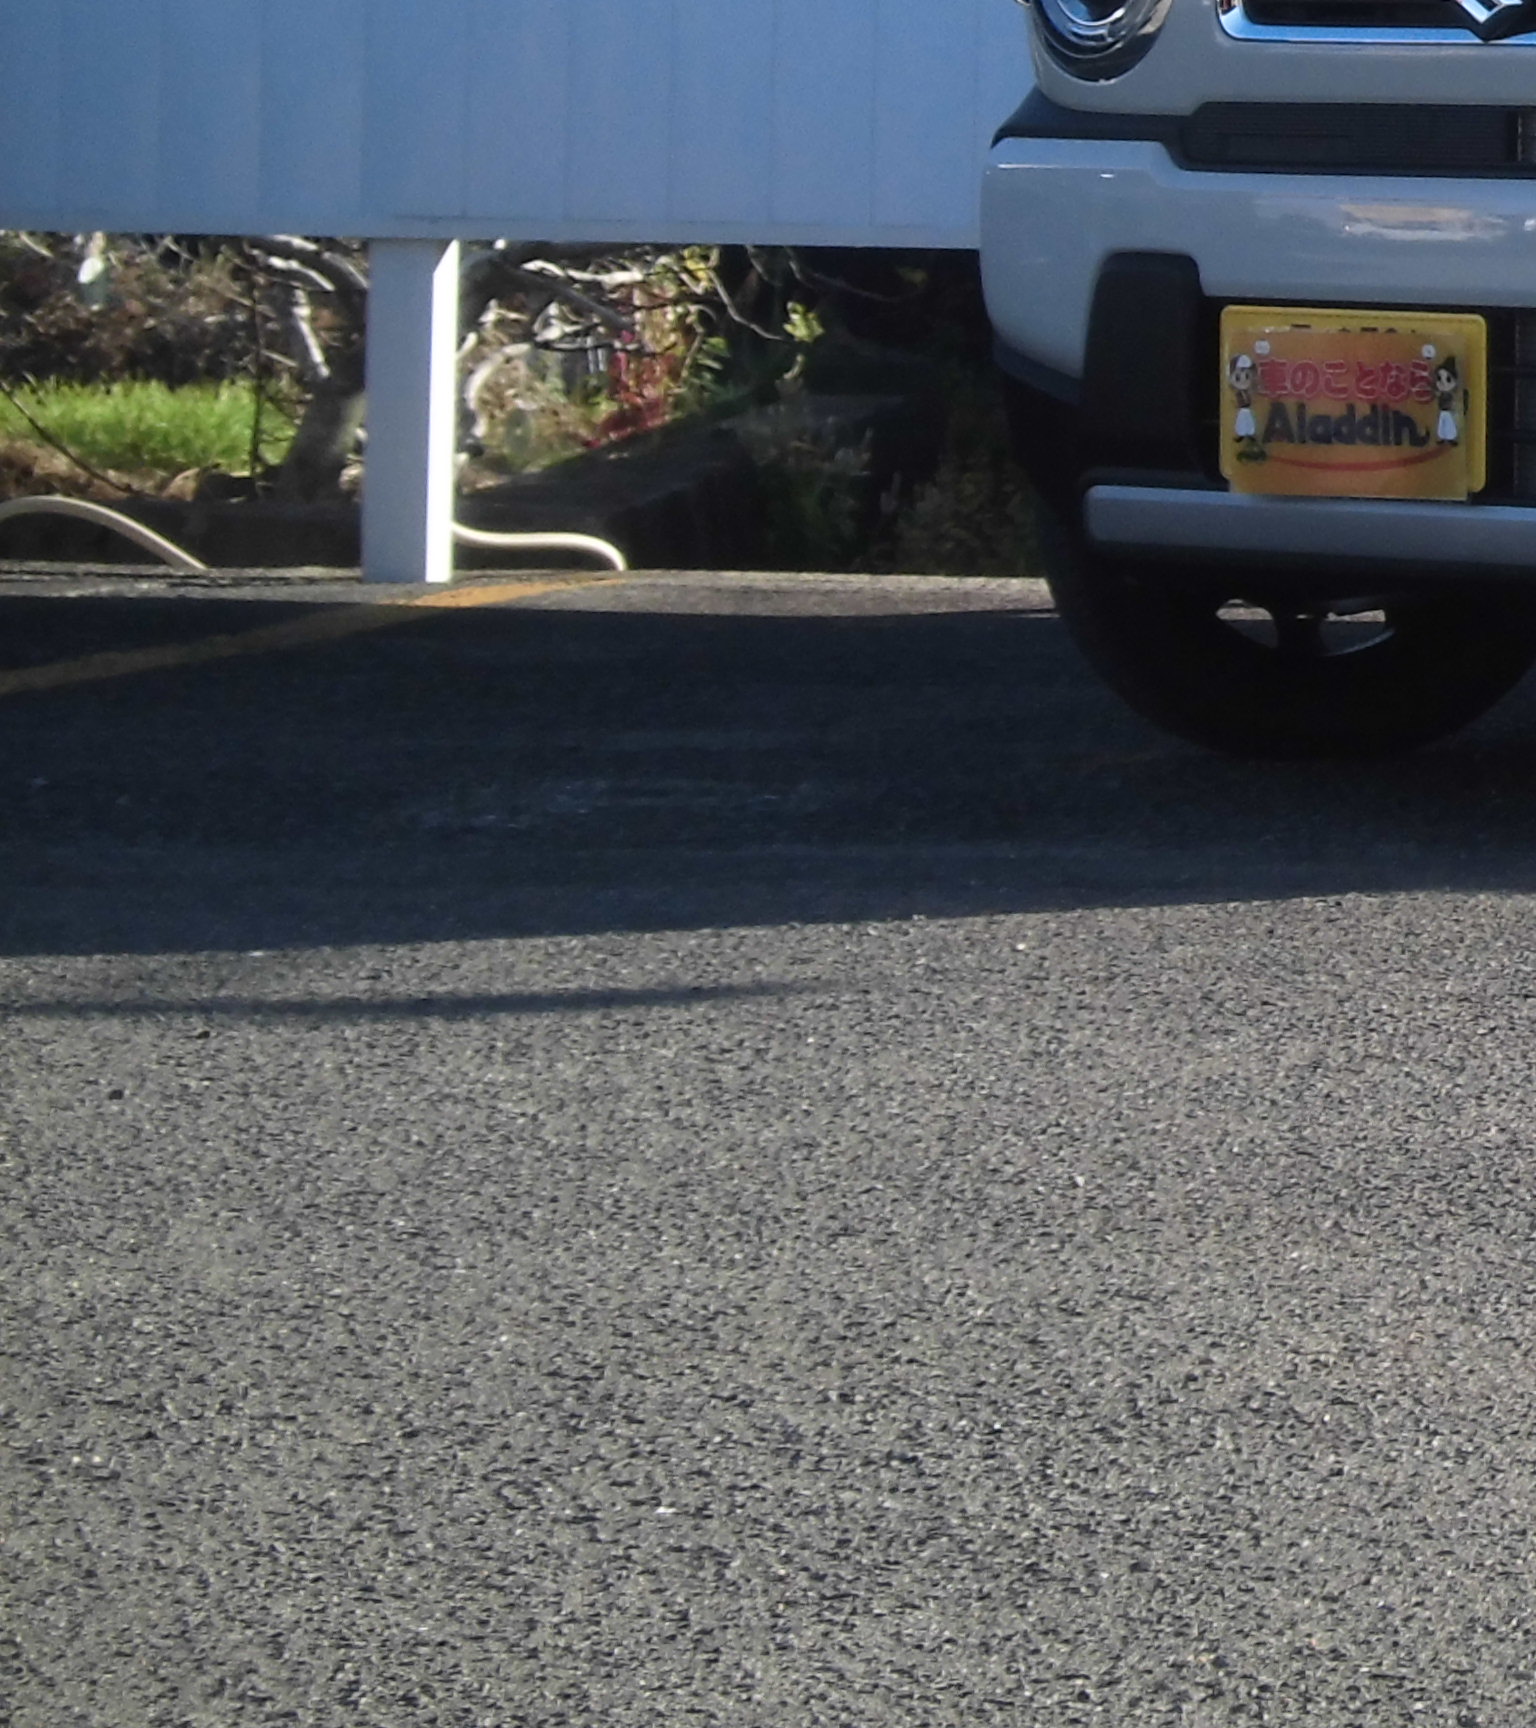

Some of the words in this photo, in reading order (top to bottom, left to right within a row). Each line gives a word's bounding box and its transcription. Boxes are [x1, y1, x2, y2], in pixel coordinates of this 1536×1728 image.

[1257, 358, 1434, 403] 車のことなら
[1263, 403, 1430, 446] Aladdin
